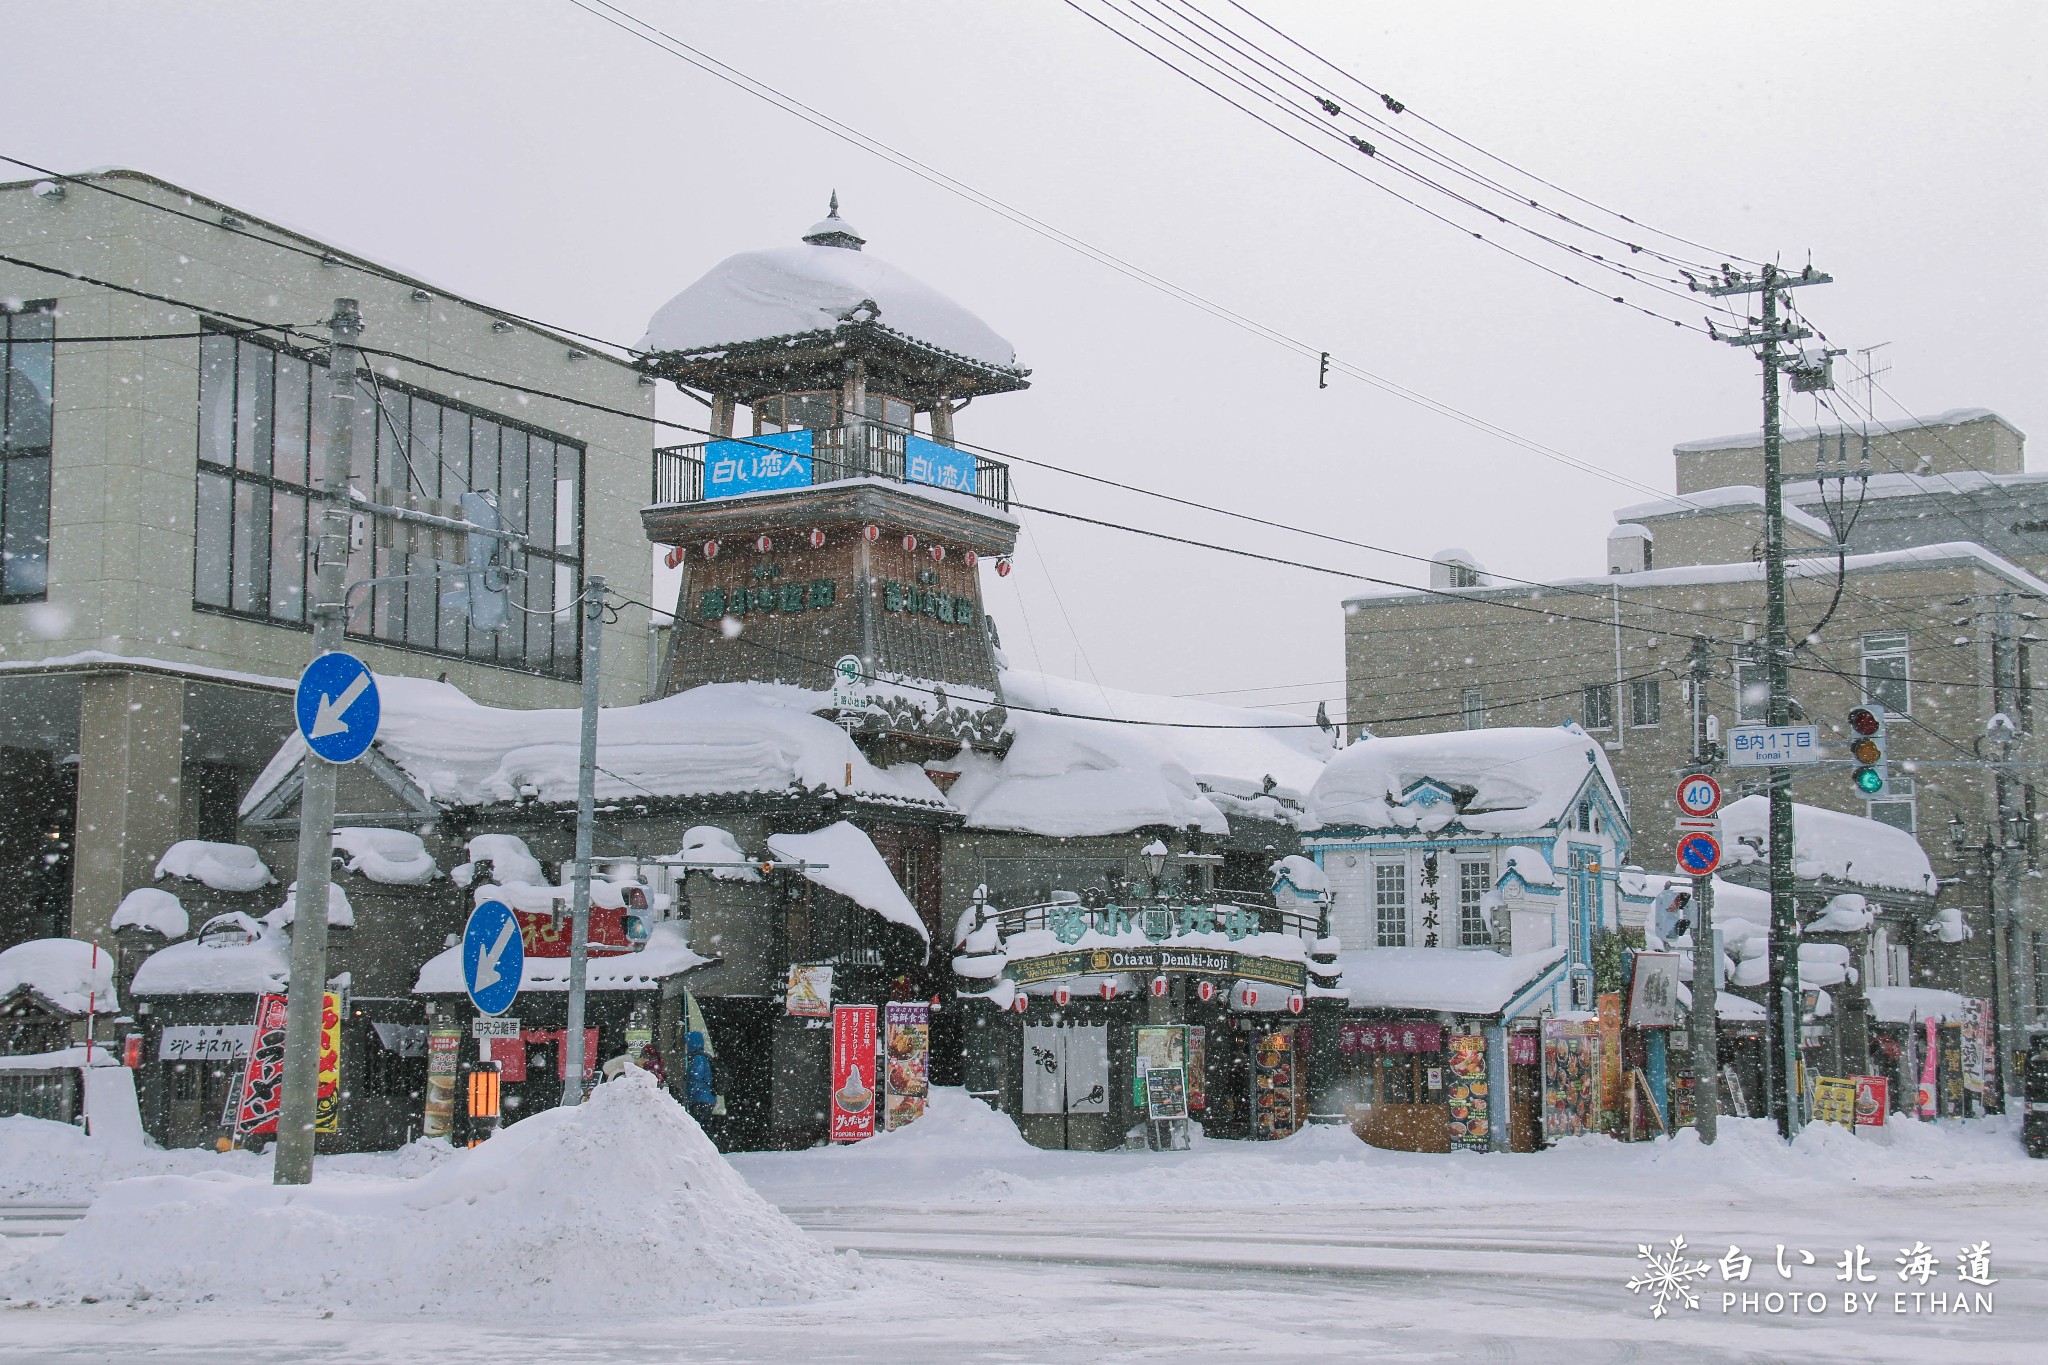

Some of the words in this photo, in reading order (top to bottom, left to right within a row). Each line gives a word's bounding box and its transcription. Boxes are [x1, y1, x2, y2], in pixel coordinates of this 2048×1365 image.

[712, 449, 804, 484] 白い恋人
[911, 454, 973, 493] 白い恋人
[1756, 751, 1781, 760] Ironai
[1785, 750, 1790, 759] 1
[1687, 786, 1711, 805] 40
[1112, 952, 1154, 966] Otaru
[1161, 952, 1228, 971] Denuki-koji
[1026, 966, 1067, 978] Welcome
[890, 1012, 929, 1023] 海鮮食堂
[474, 1021, 519, 1035] 中央分離帯
[170, 1039, 244, 1053] ジンギスカン
